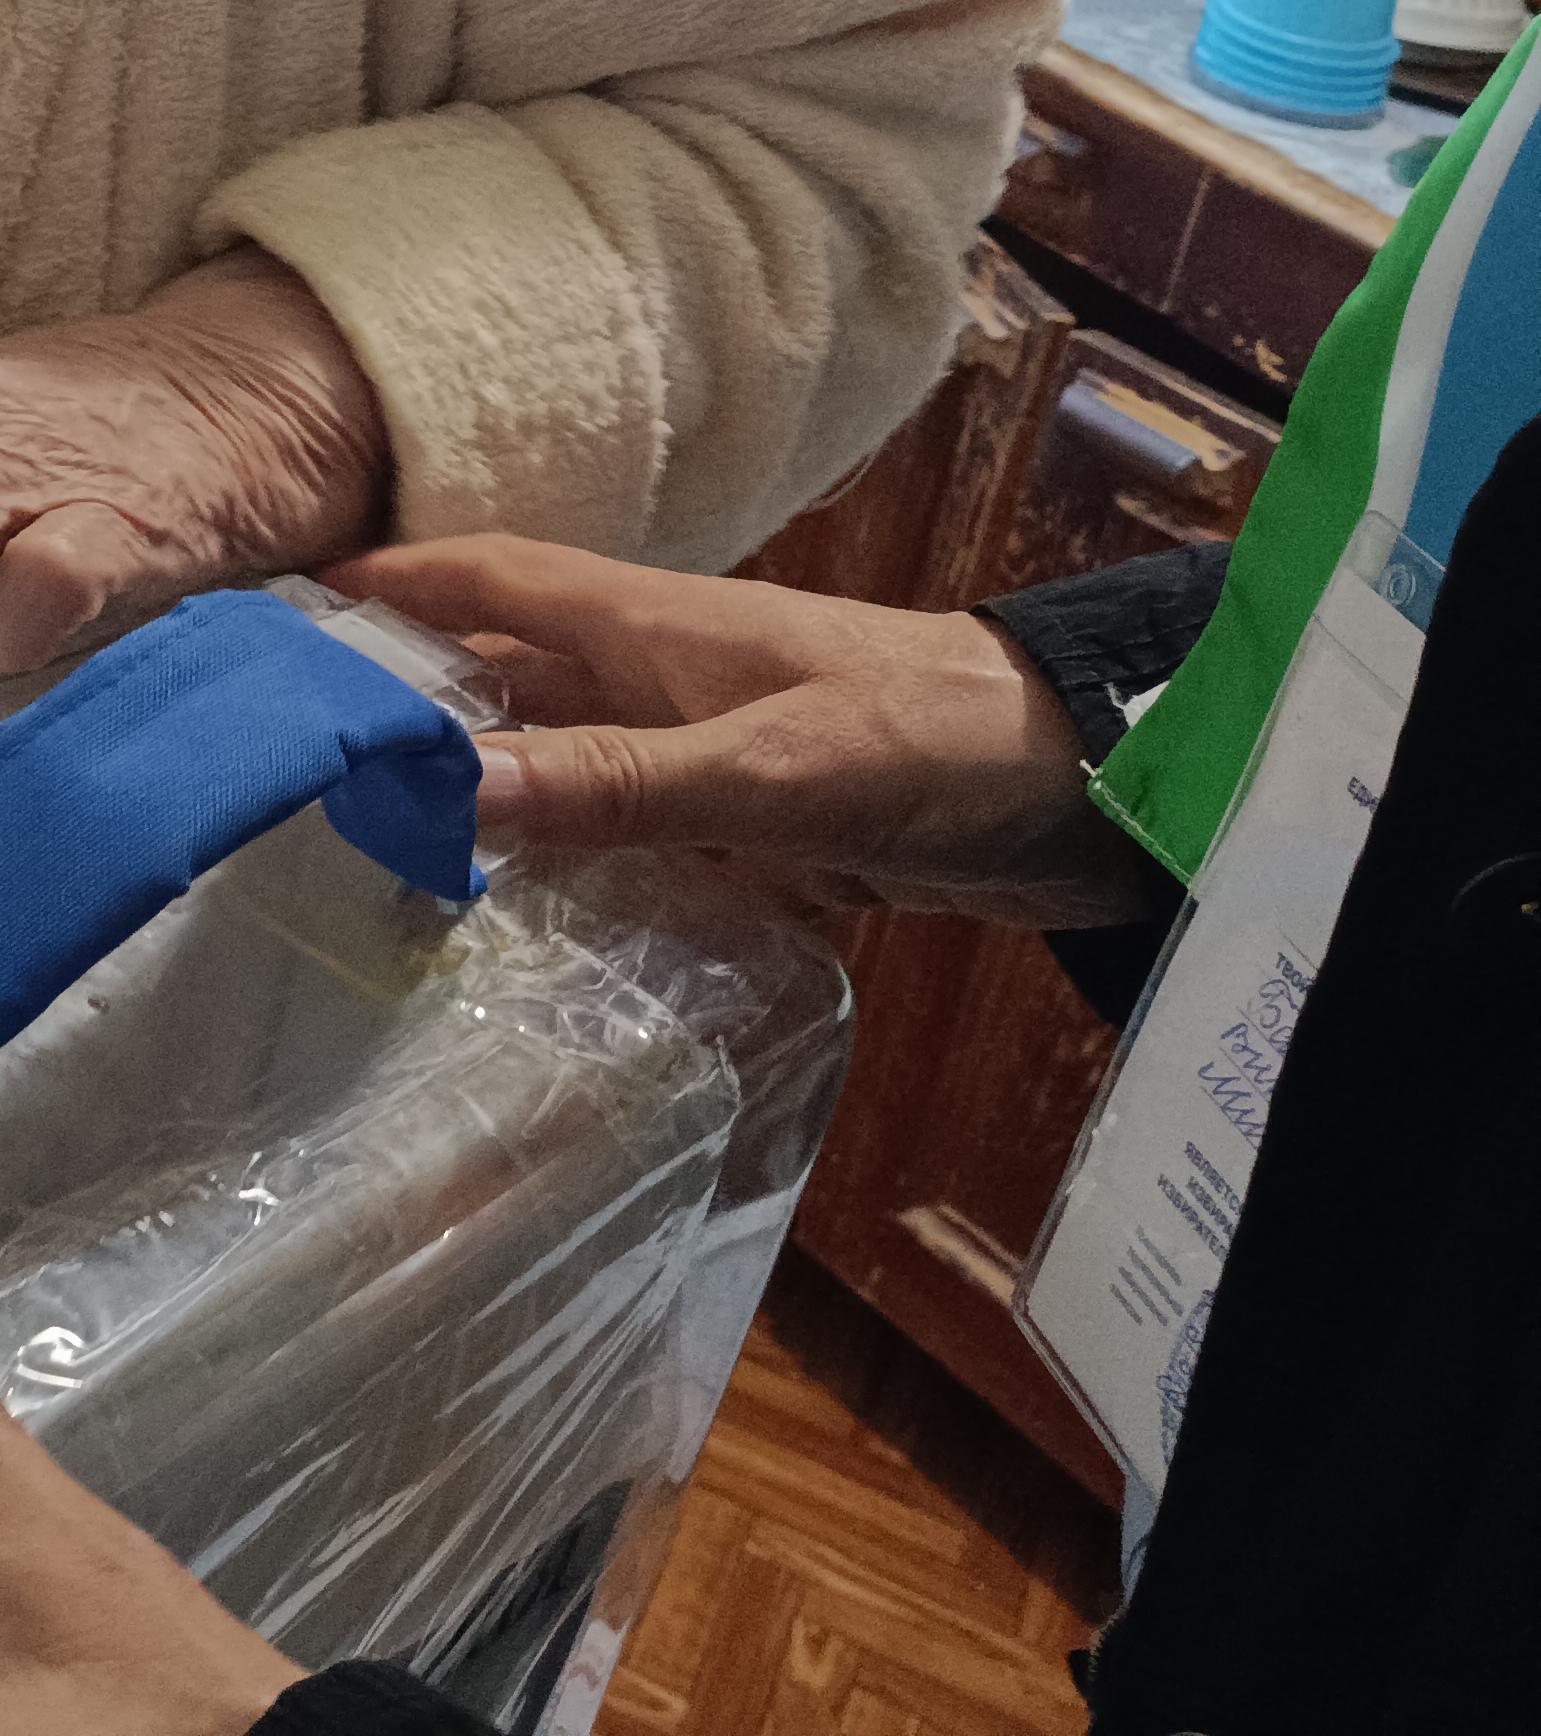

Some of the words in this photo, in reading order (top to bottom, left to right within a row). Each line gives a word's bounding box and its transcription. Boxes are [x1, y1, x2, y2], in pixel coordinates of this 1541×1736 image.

[1184, 1140, 1243, 1216] ЯВЛЯЕТС
[1185, 1175, 1234, 1238] ИЗБИРА
[1157, 1173, 1231, 1262] ИЗБИРАТЕЛ
